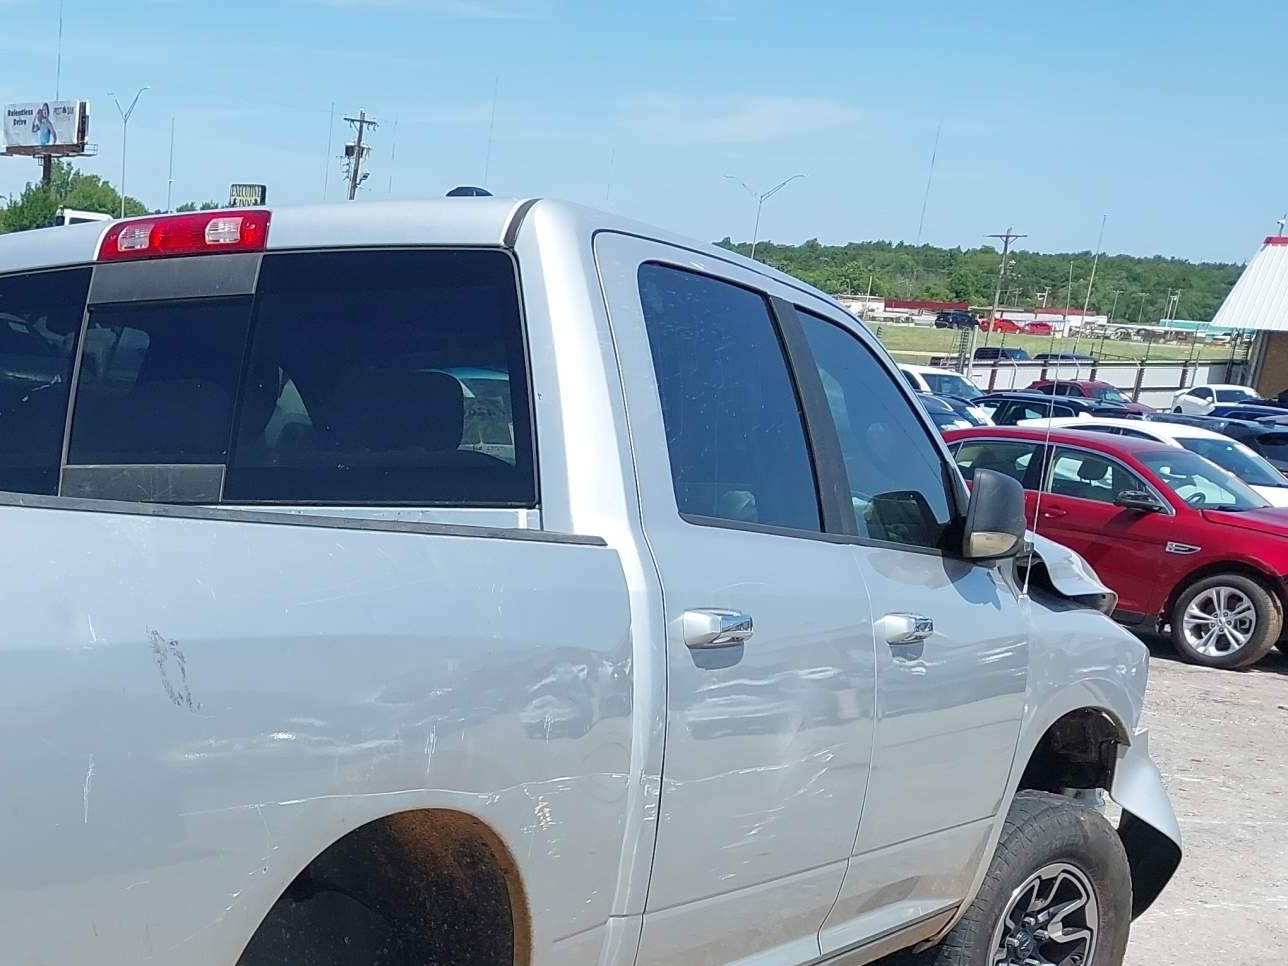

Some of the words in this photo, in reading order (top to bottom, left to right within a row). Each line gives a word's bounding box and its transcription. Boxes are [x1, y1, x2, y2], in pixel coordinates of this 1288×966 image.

[7, 108, 34, 117] Relentless
[13, 118, 27, 126] Drive
[231, 185, 261, 198] EXECUTIVE
[239, 198, 252, 207] INN
